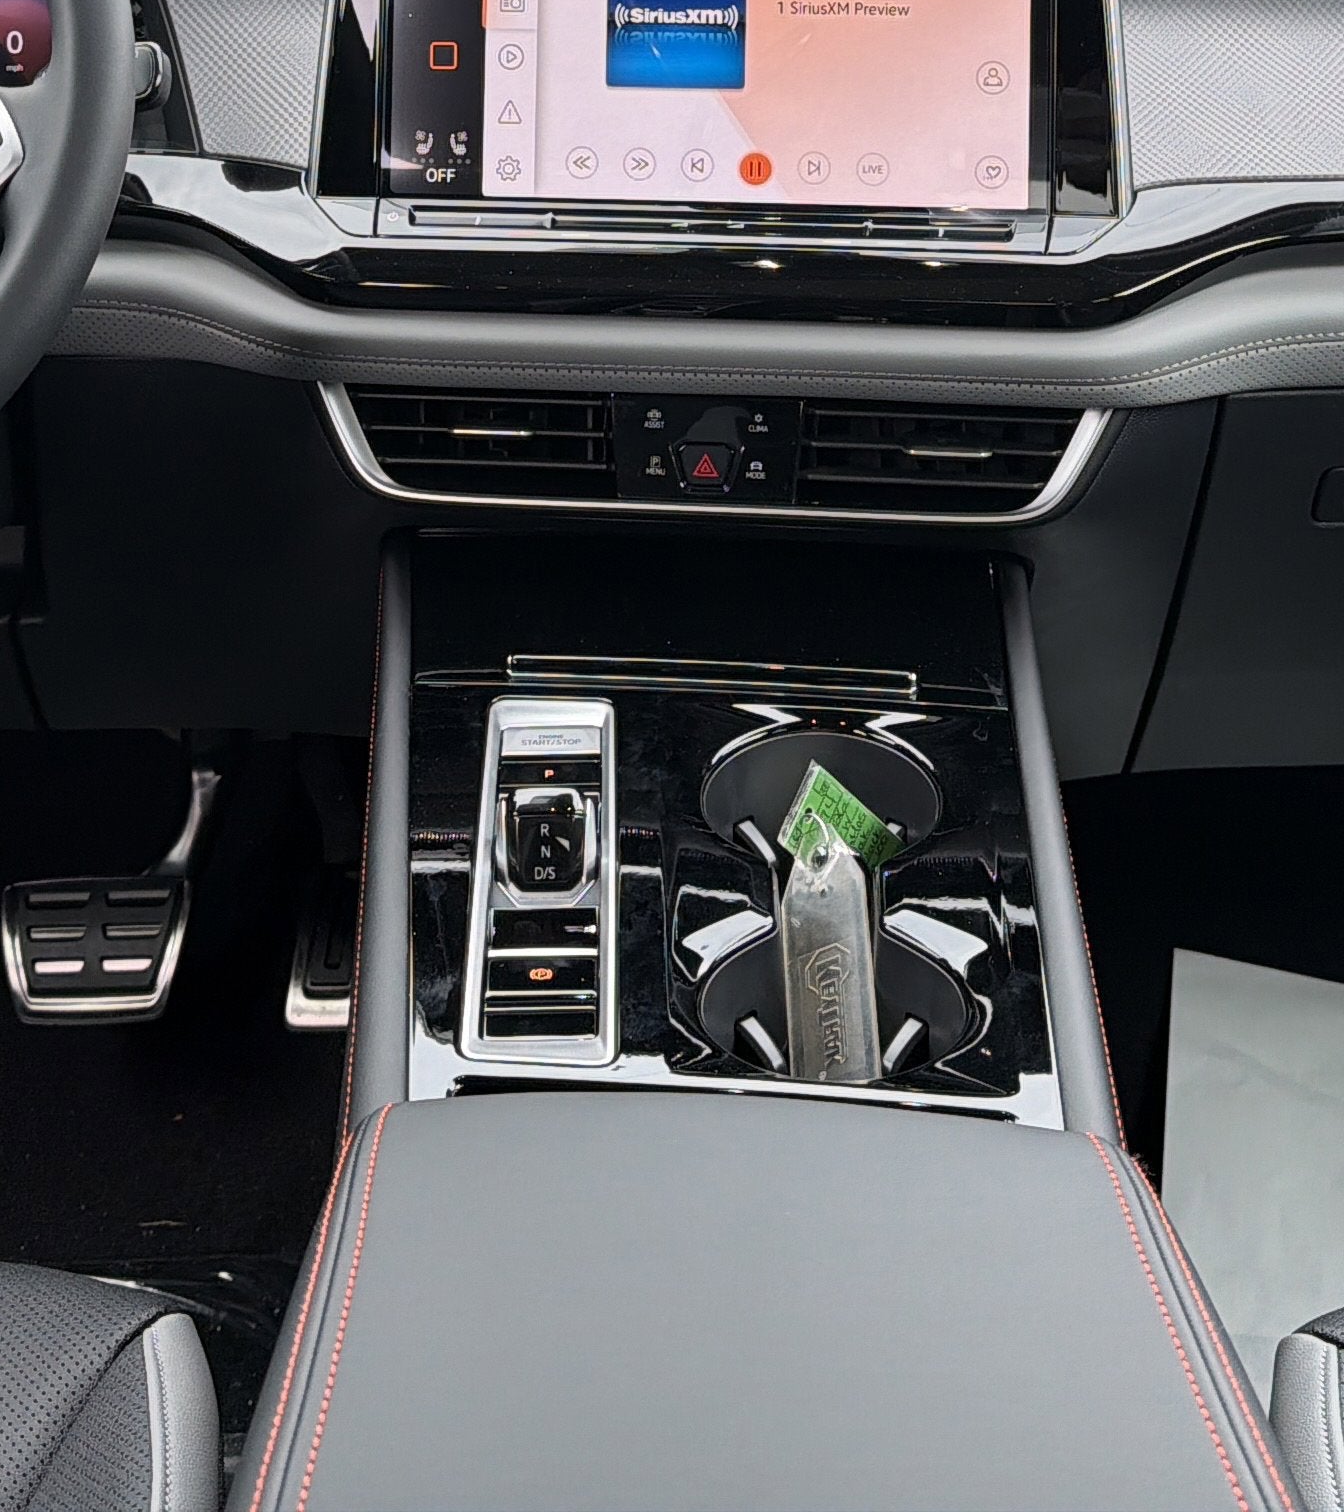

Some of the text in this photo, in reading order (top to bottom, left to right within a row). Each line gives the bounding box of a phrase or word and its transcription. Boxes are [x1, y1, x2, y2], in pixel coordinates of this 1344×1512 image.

[777, 0, 910, 17] 1 SiriusXM Preview
[6, 30, 23, 54] 0
[425, 167, 457, 183] OFF
[861, 164, 884, 175] LIVE
[643, 420, 665, 429] ASSIST
[747, 424, 769, 433] CLIMA
[645, 467, 666, 477] MENU
[745, 471, 767, 480] MODE
[520, 737, 582, 746] START/STOP
[544, 769, 555, 779] P
[540, 823, 550, 837] R
[540, 845, 551, 858] N
[534, 866, 556, 881] D/S
